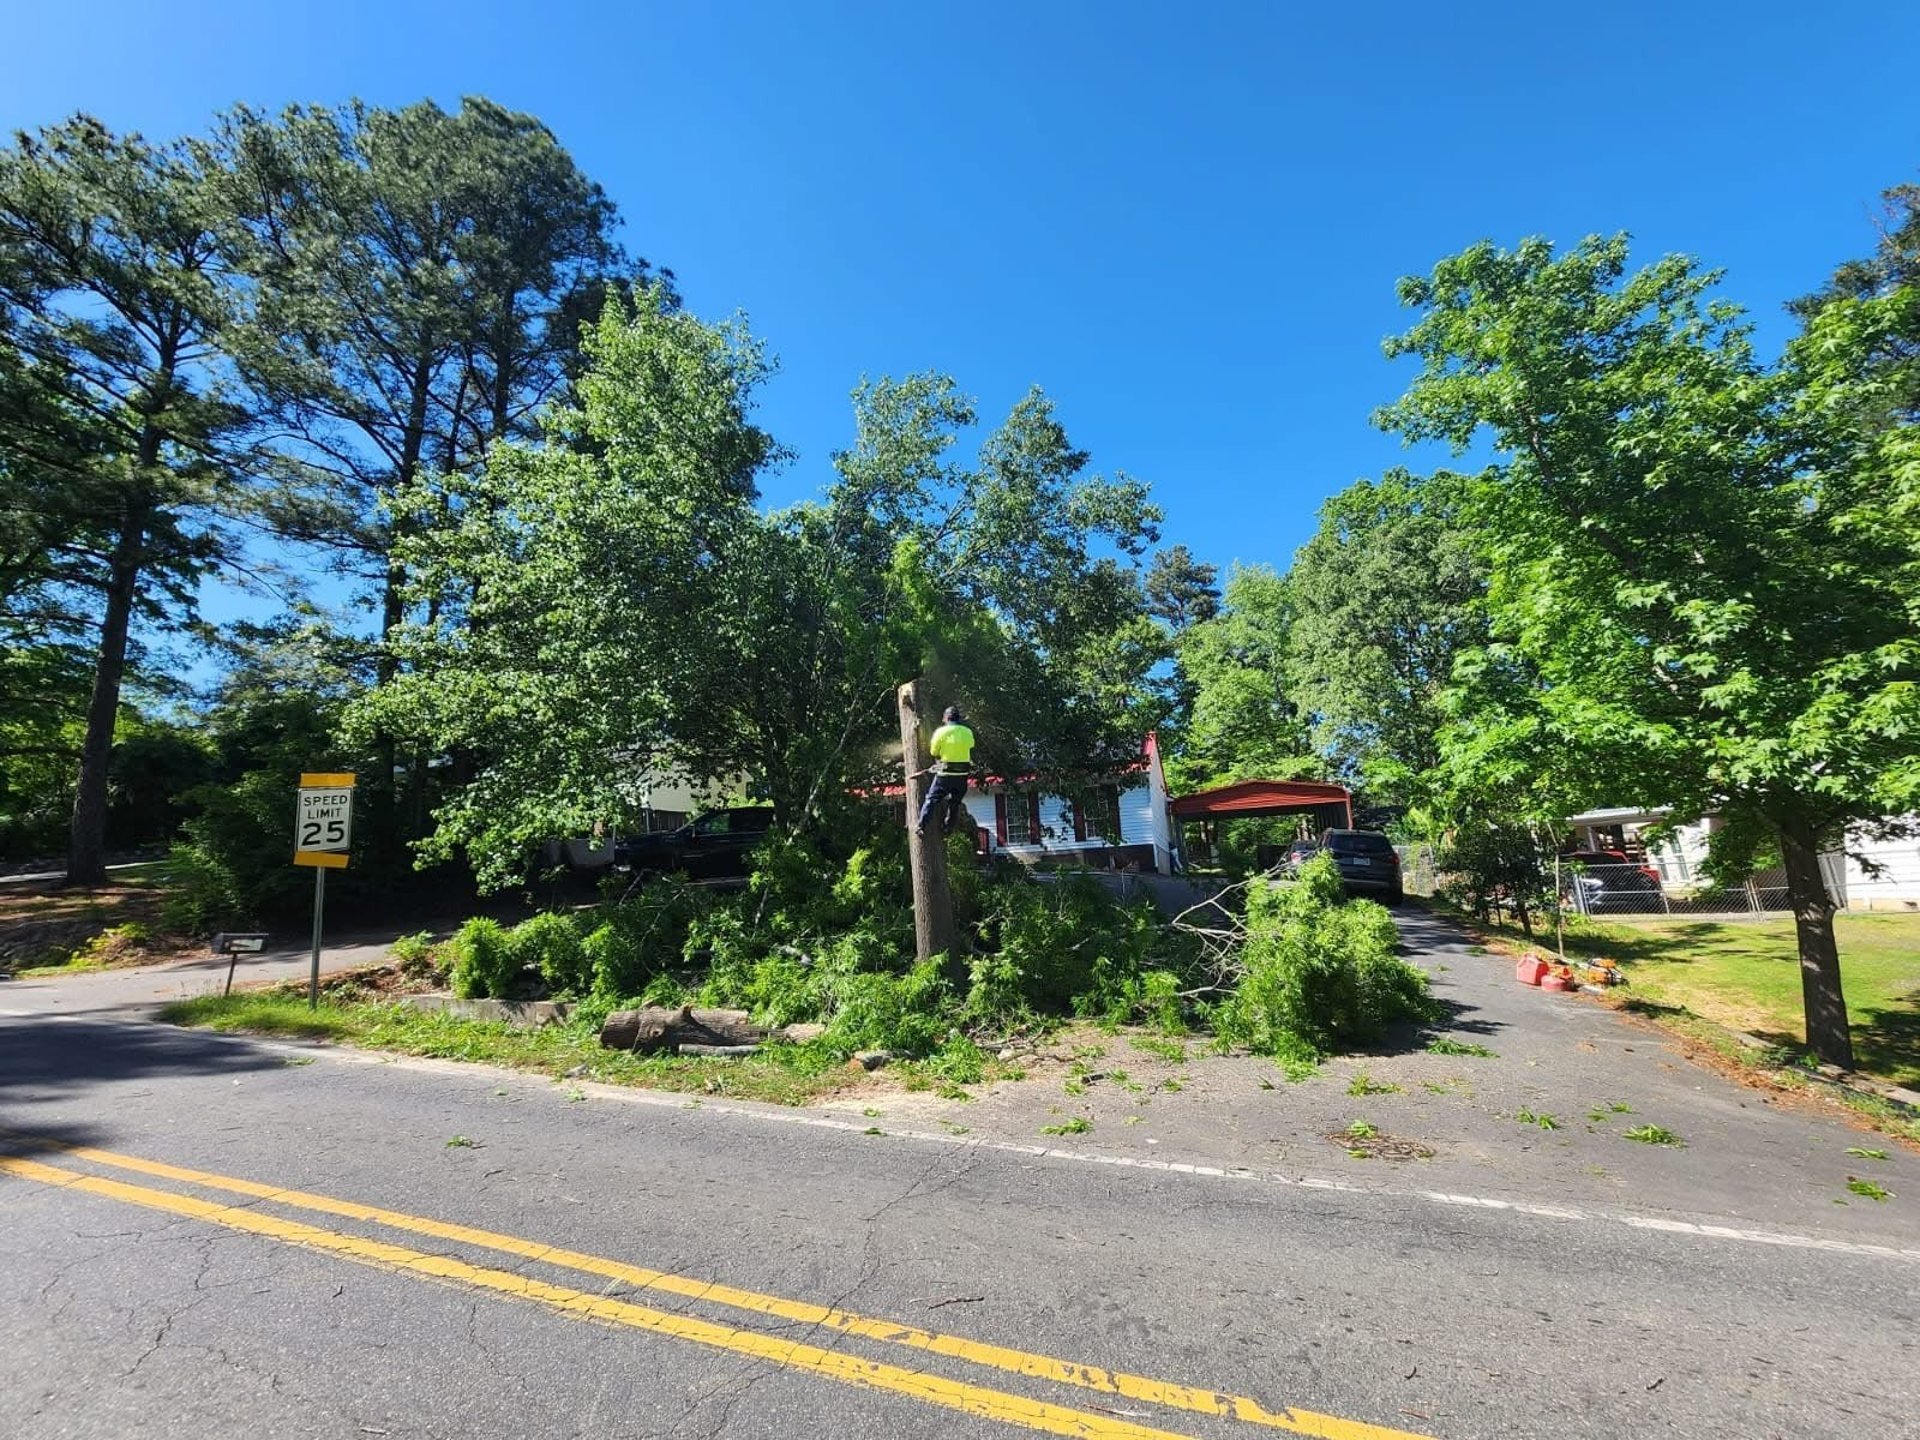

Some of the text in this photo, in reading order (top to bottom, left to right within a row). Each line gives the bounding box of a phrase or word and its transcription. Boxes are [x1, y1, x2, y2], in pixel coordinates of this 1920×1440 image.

[304, 795, 348, 806] SPEED
[308, 808, 341, 819] LIMIT
[302, 821, 344, 846] 25
